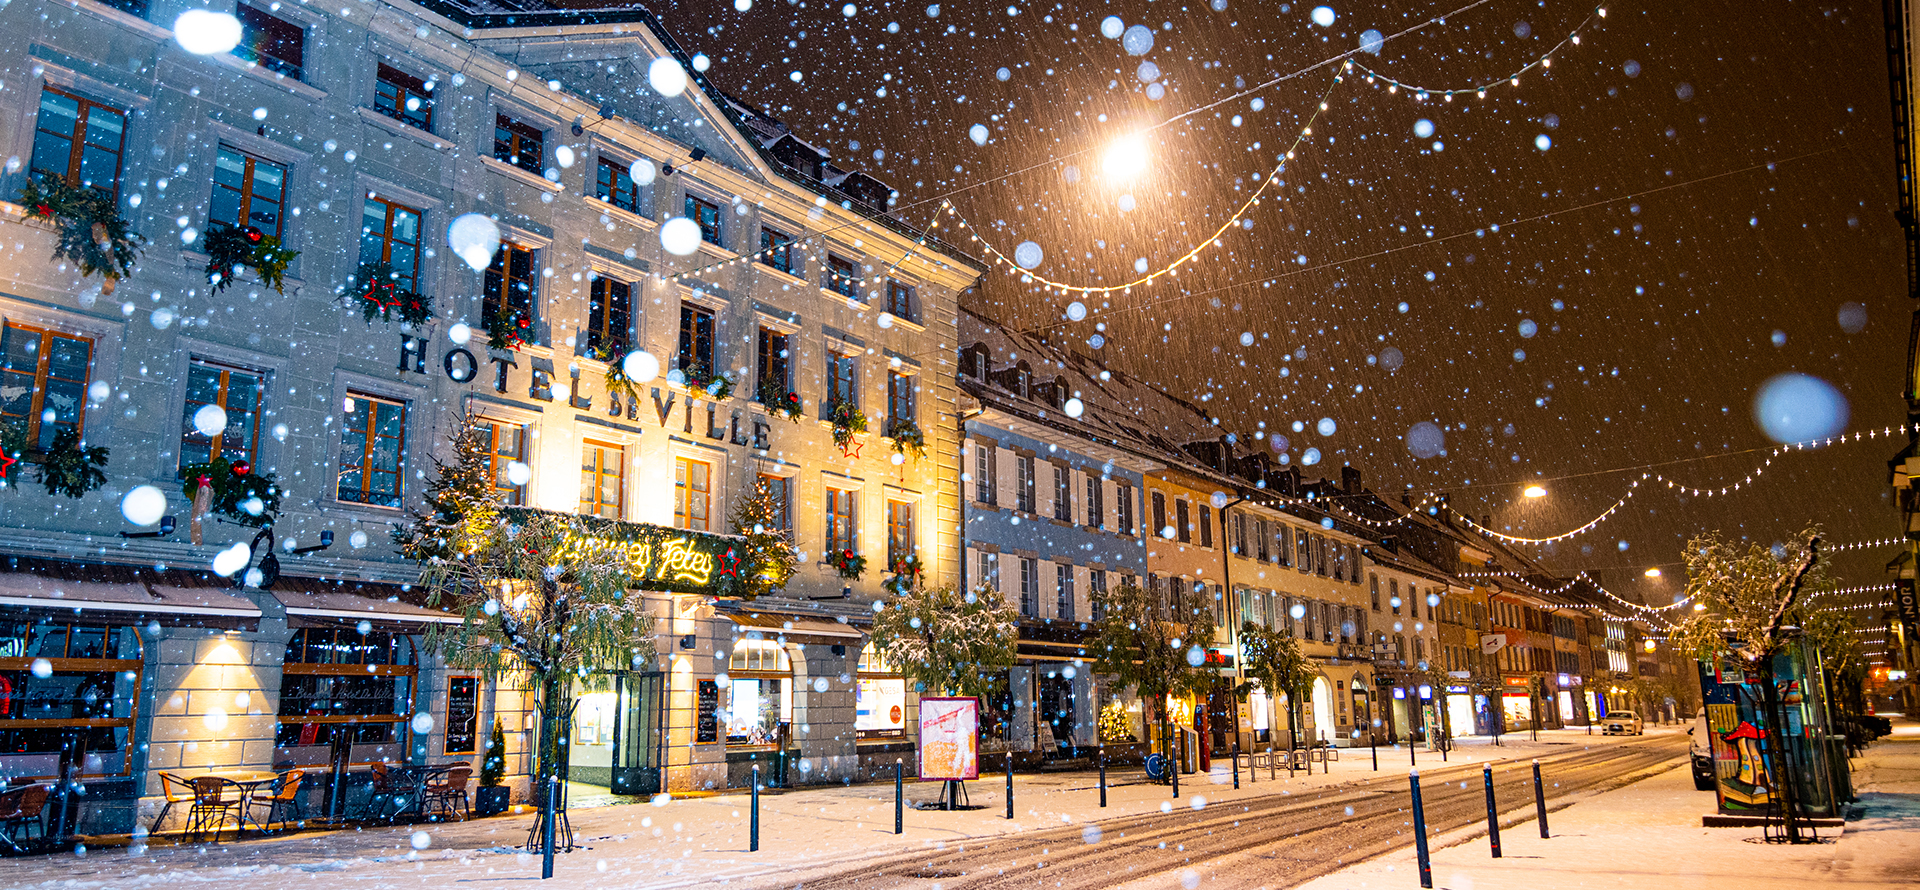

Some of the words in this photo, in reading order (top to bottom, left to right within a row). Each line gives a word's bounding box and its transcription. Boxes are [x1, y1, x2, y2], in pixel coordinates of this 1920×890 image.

[397, 333, 592, 411] HOTEL
[609, 399, 641, 422] DE
[650, 391, 771, 451] VILLE
